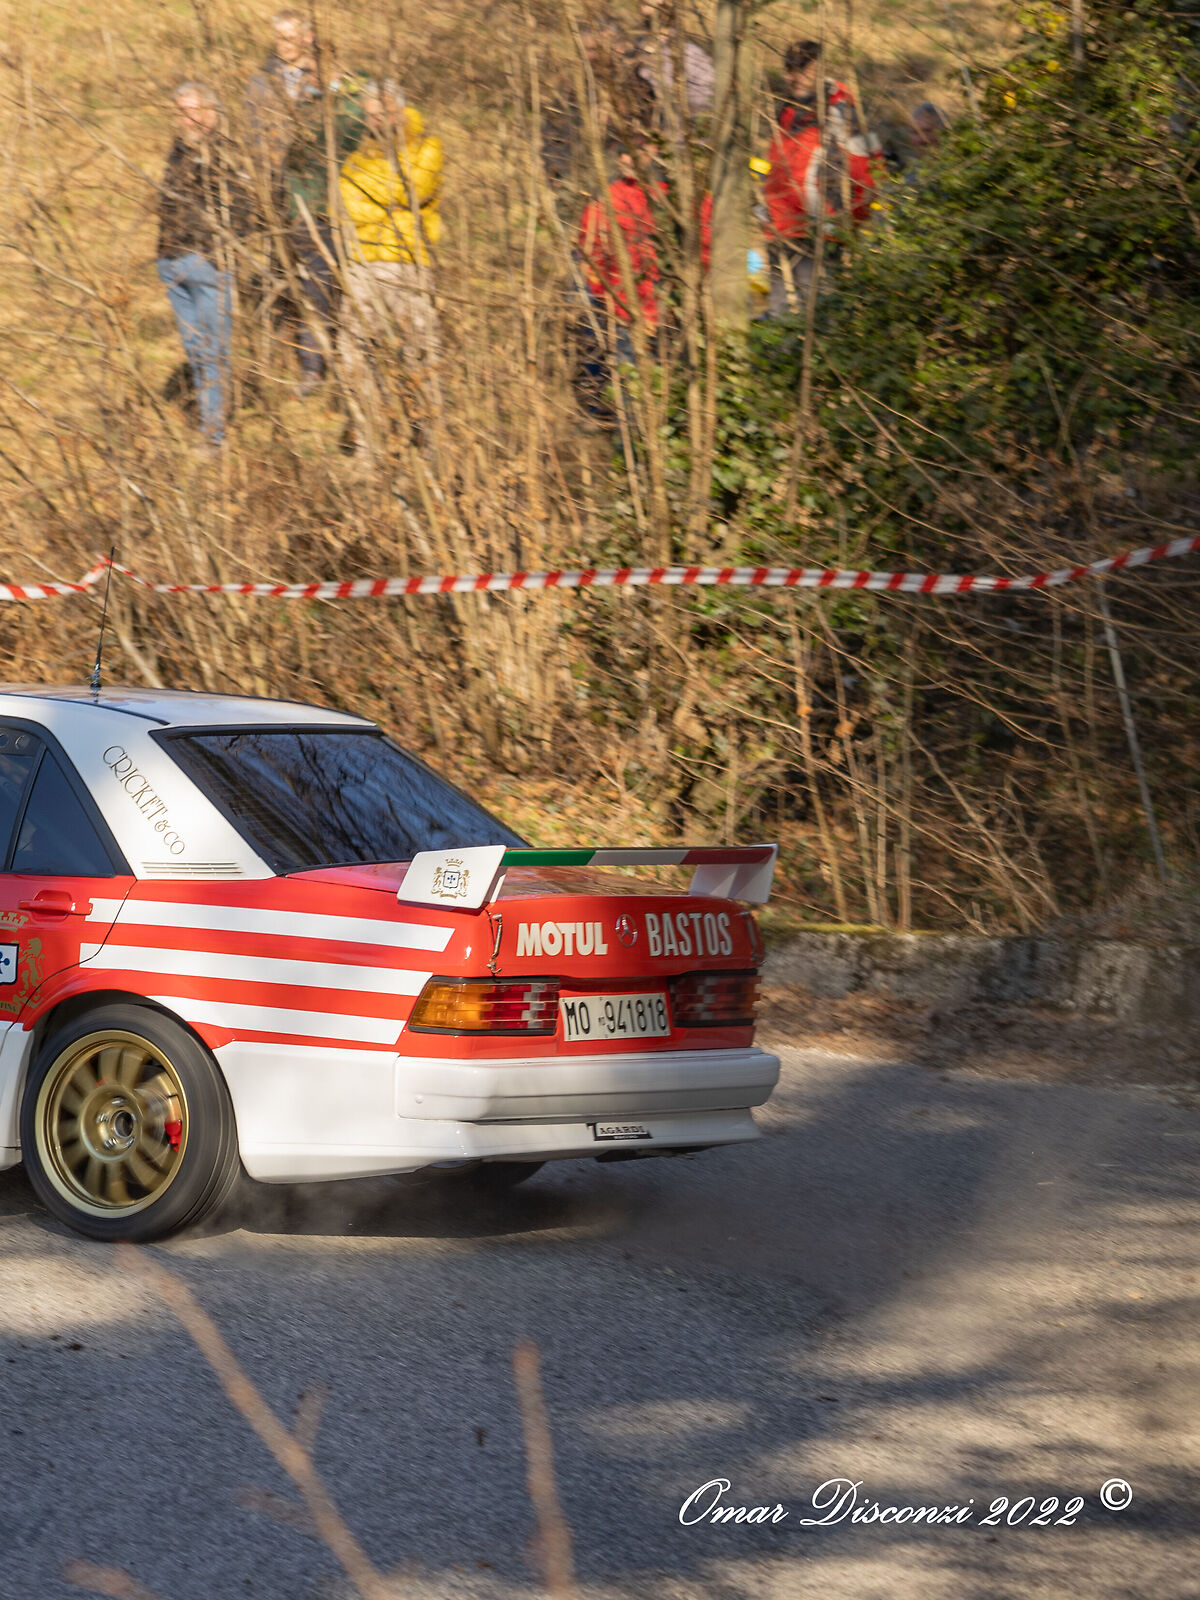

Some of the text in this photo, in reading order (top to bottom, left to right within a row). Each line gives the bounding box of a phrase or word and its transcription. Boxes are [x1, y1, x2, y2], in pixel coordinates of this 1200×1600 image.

[102, 745, 185, 854] CRICKET & CO
[516, 912, 733, 956] MOTUL BASTOS
[564, 998, 668, 1036] MO 941818
